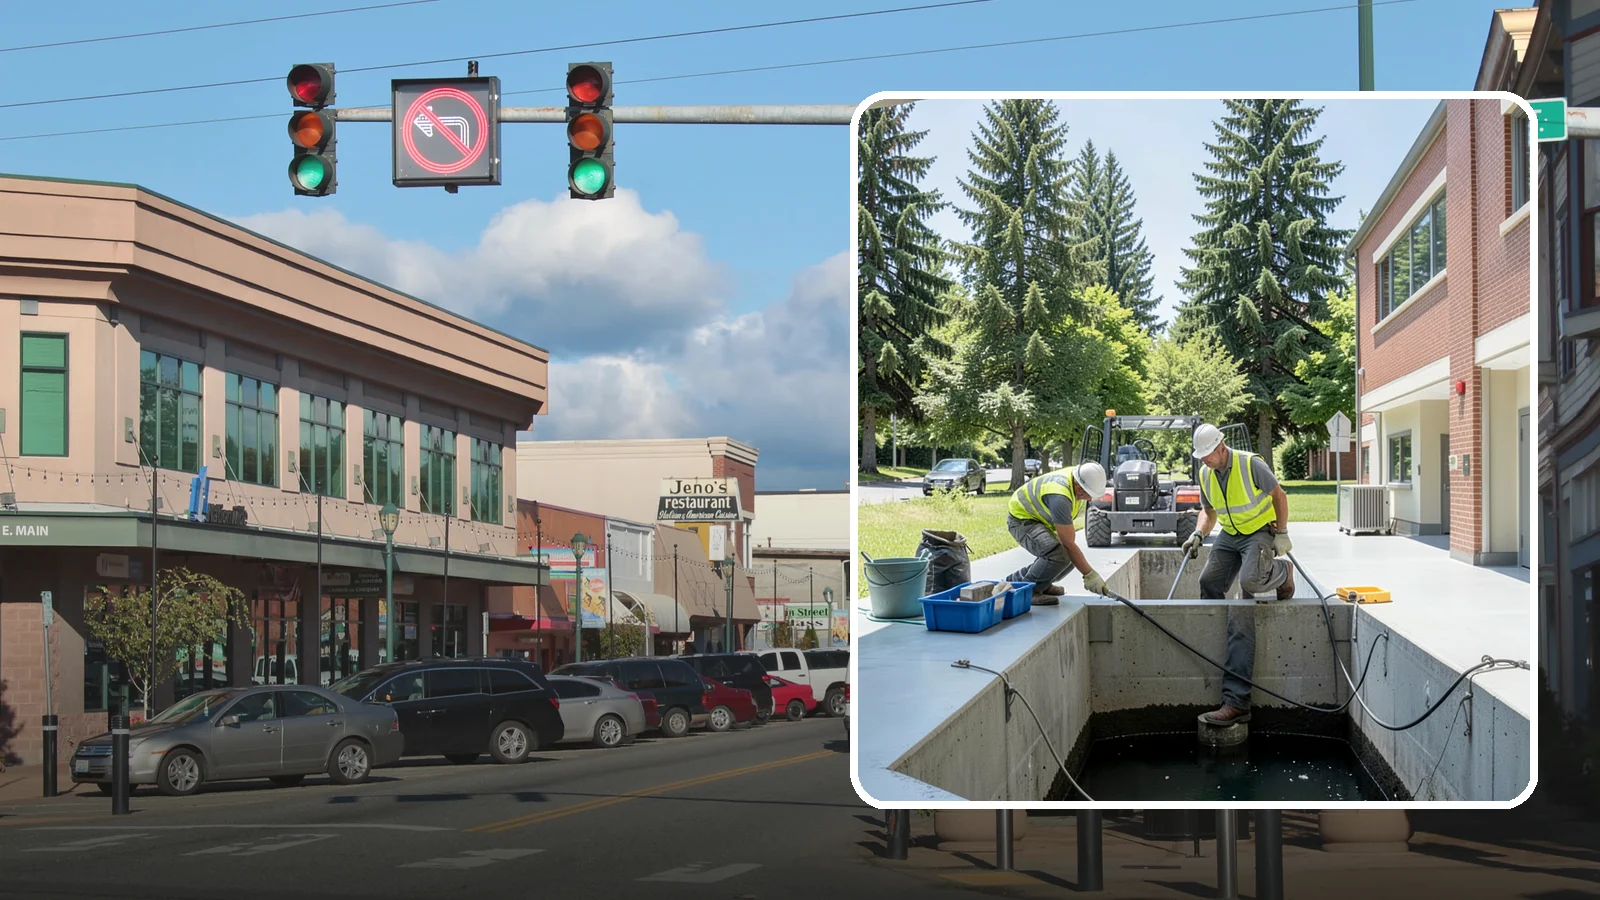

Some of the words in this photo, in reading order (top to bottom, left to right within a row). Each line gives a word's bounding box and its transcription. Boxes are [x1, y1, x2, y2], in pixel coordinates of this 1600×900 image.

[670, 480, 727, 494] Jeno's
[665, 497, 731, 508] restaurant
[658, 510, 681, 519] Italian
[686, 510, 714, 519] American
[715, 510, 737, 519] Cuisine
[2, 525, 13, 536] E.
[15, 525, 49, 536] MAIN
[797, 608, 828, 616] Street
